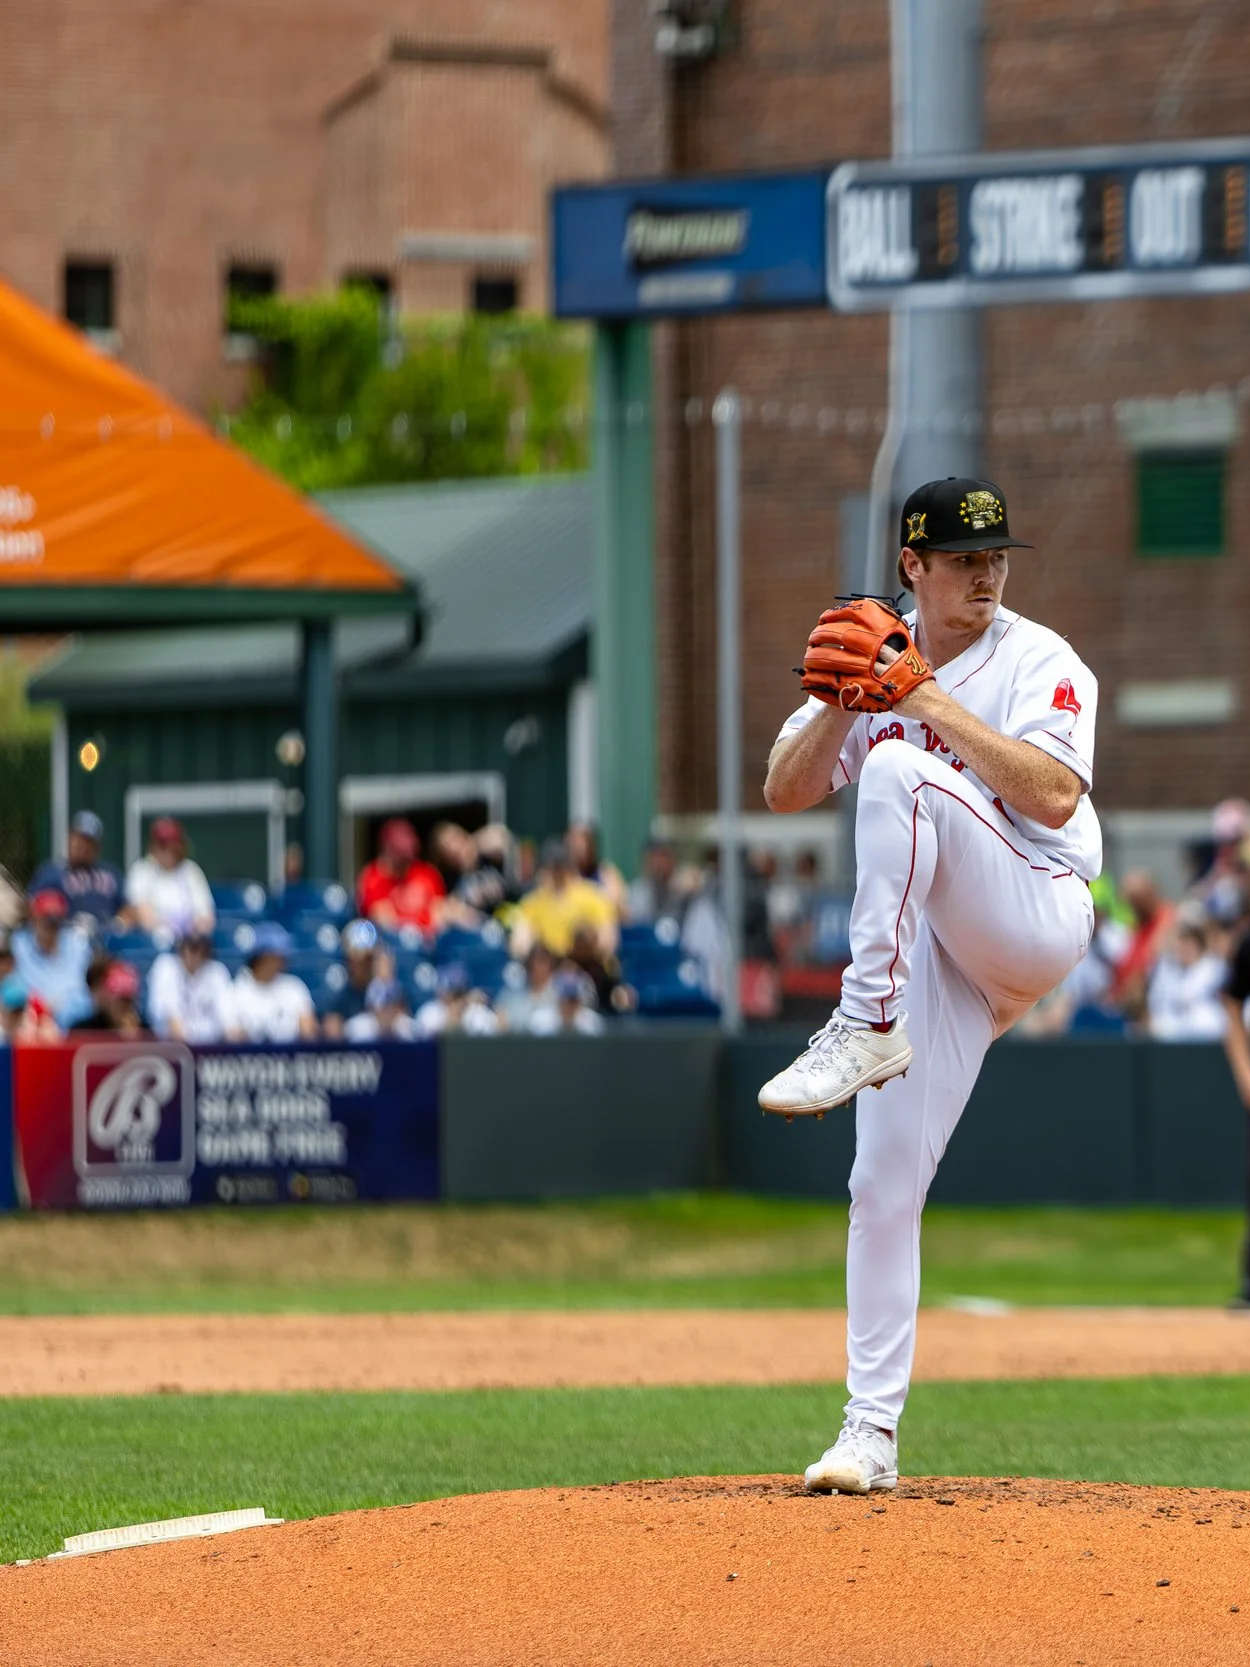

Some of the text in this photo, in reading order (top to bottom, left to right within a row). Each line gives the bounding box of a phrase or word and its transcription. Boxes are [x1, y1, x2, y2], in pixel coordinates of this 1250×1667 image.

[837, 185, 918, 283] BALL
[970, 174, 1086, 273] STRIKE
[1131, 167, 1207, 264] OUT
[869, 716, 905, 750] ea
